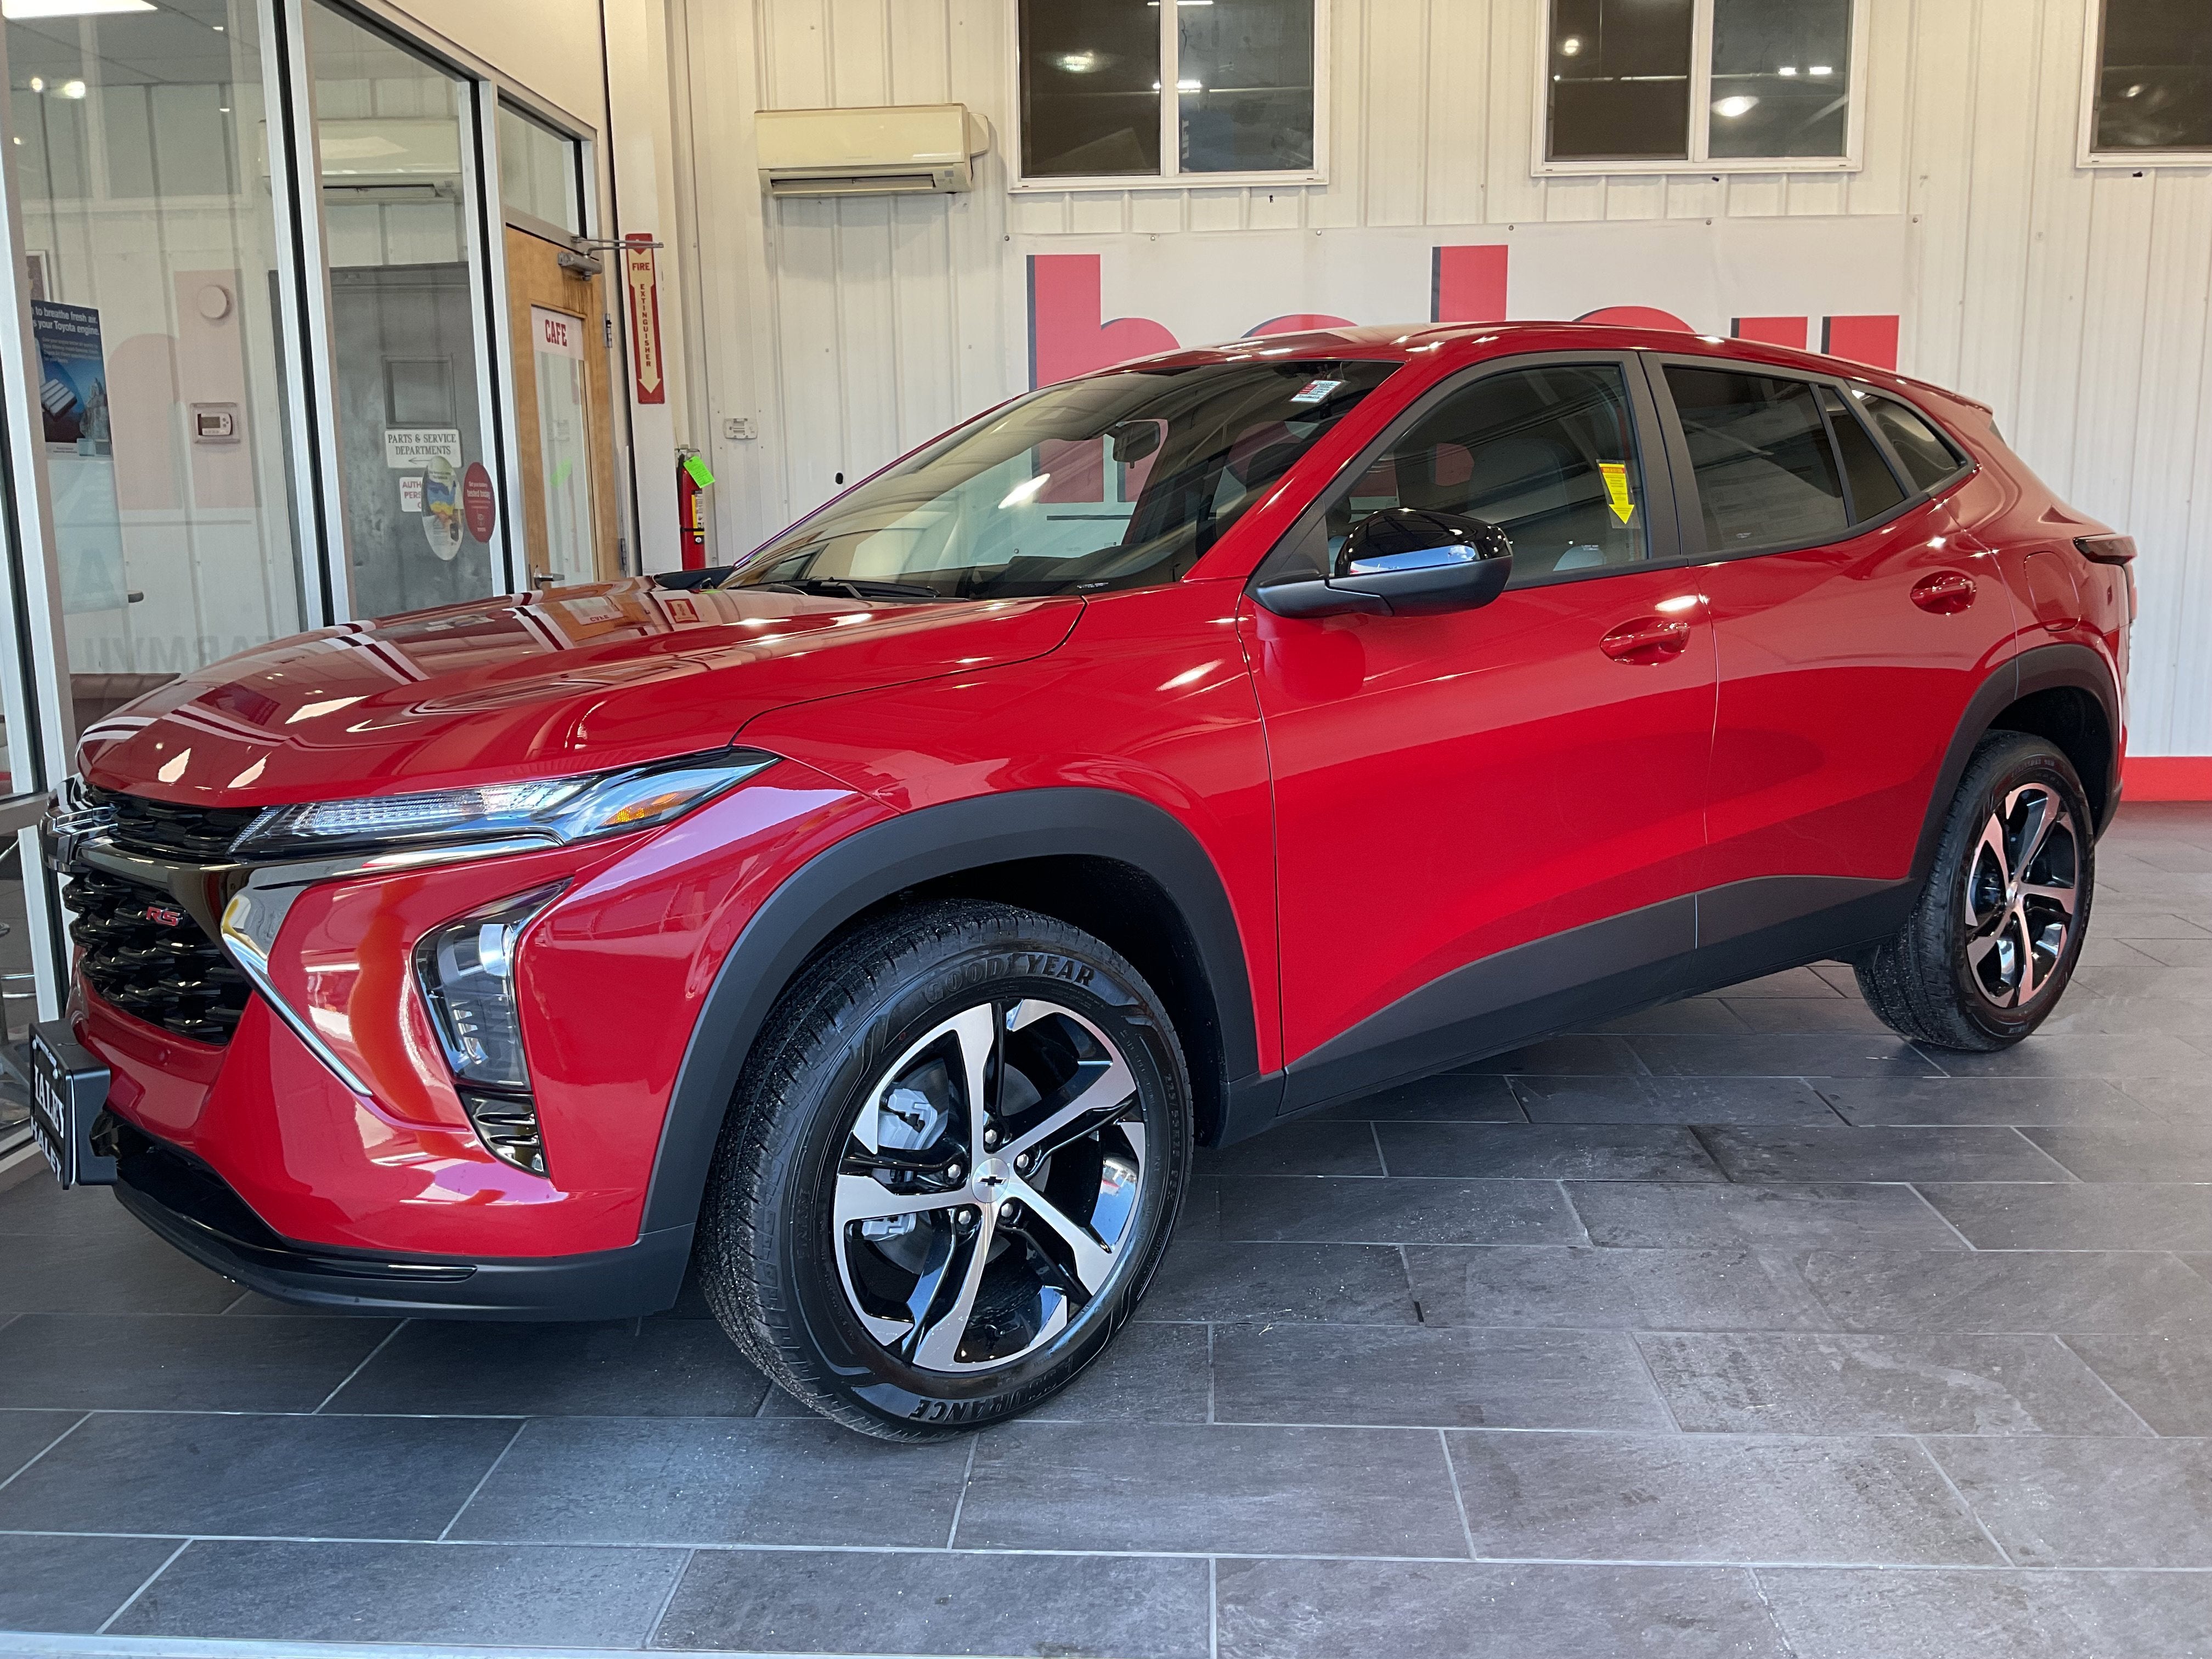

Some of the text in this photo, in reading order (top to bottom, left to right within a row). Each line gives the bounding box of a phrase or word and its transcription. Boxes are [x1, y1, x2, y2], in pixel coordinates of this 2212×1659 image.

[632, 262, 650, 271] FIRE
[35, 306, 43, 316] to
[44, 307, 70, 320] breathe
[70, 311, 87, 323] fresh
[37, 320, 53, 330] your
[54, 320, 76, 332] Toyota
[545, 319, 567, 347] CAFE
[640, 283, 652, 367] EXTINGUISHER
[387, 433, 456, 444] PARTS & SERVICE
[395, 445, 451, 455] DEPARTMENTS
[146, 906, 179, 927] RS
[30, 1114, 61, 1183] HALEY
